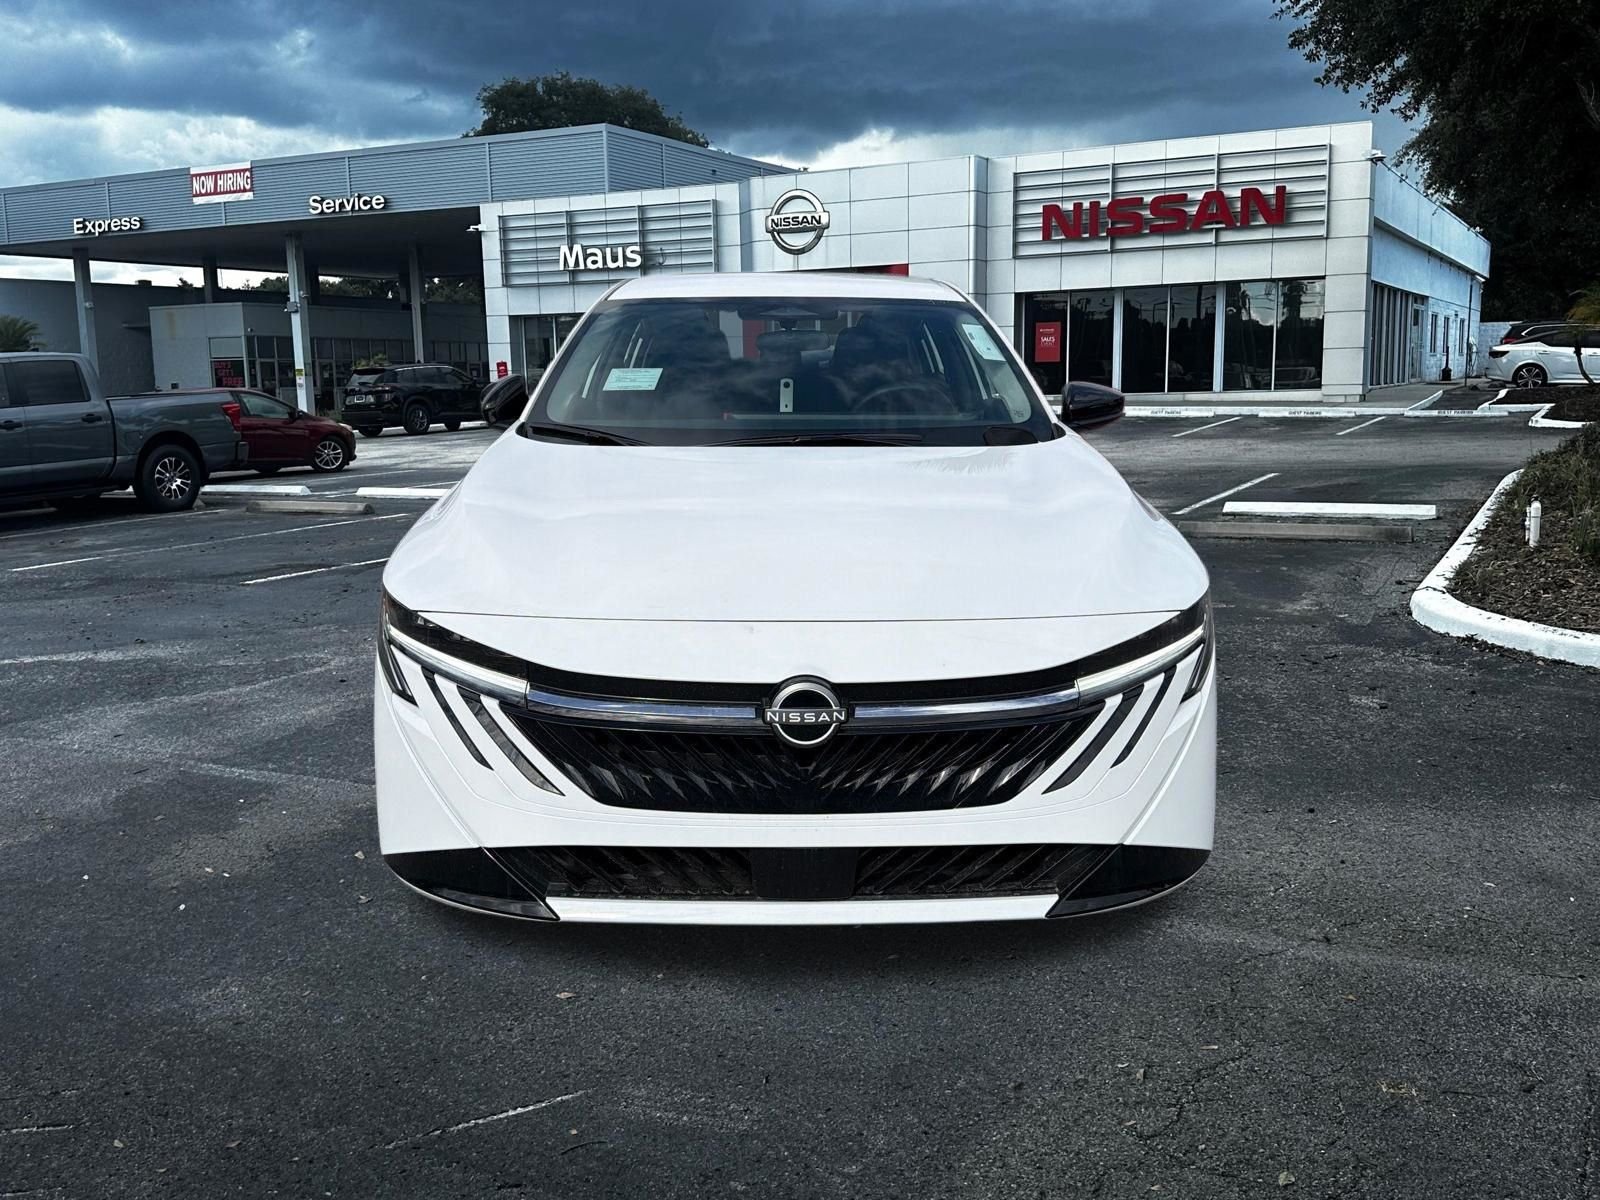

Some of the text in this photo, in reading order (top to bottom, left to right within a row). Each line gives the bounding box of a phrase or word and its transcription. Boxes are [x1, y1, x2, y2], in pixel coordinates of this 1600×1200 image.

[192, 171, 251, 195] NOW HIRING
[308, 193, 386, 215] Service
[1042, 185, 1287, 242] NISSAN
[72, 215, 141, 236] Express
[770, 214, 822, 230] NISSAN
[558, 243, 642, 272] Maus
[767, 711, 845, 722] NISSAN
